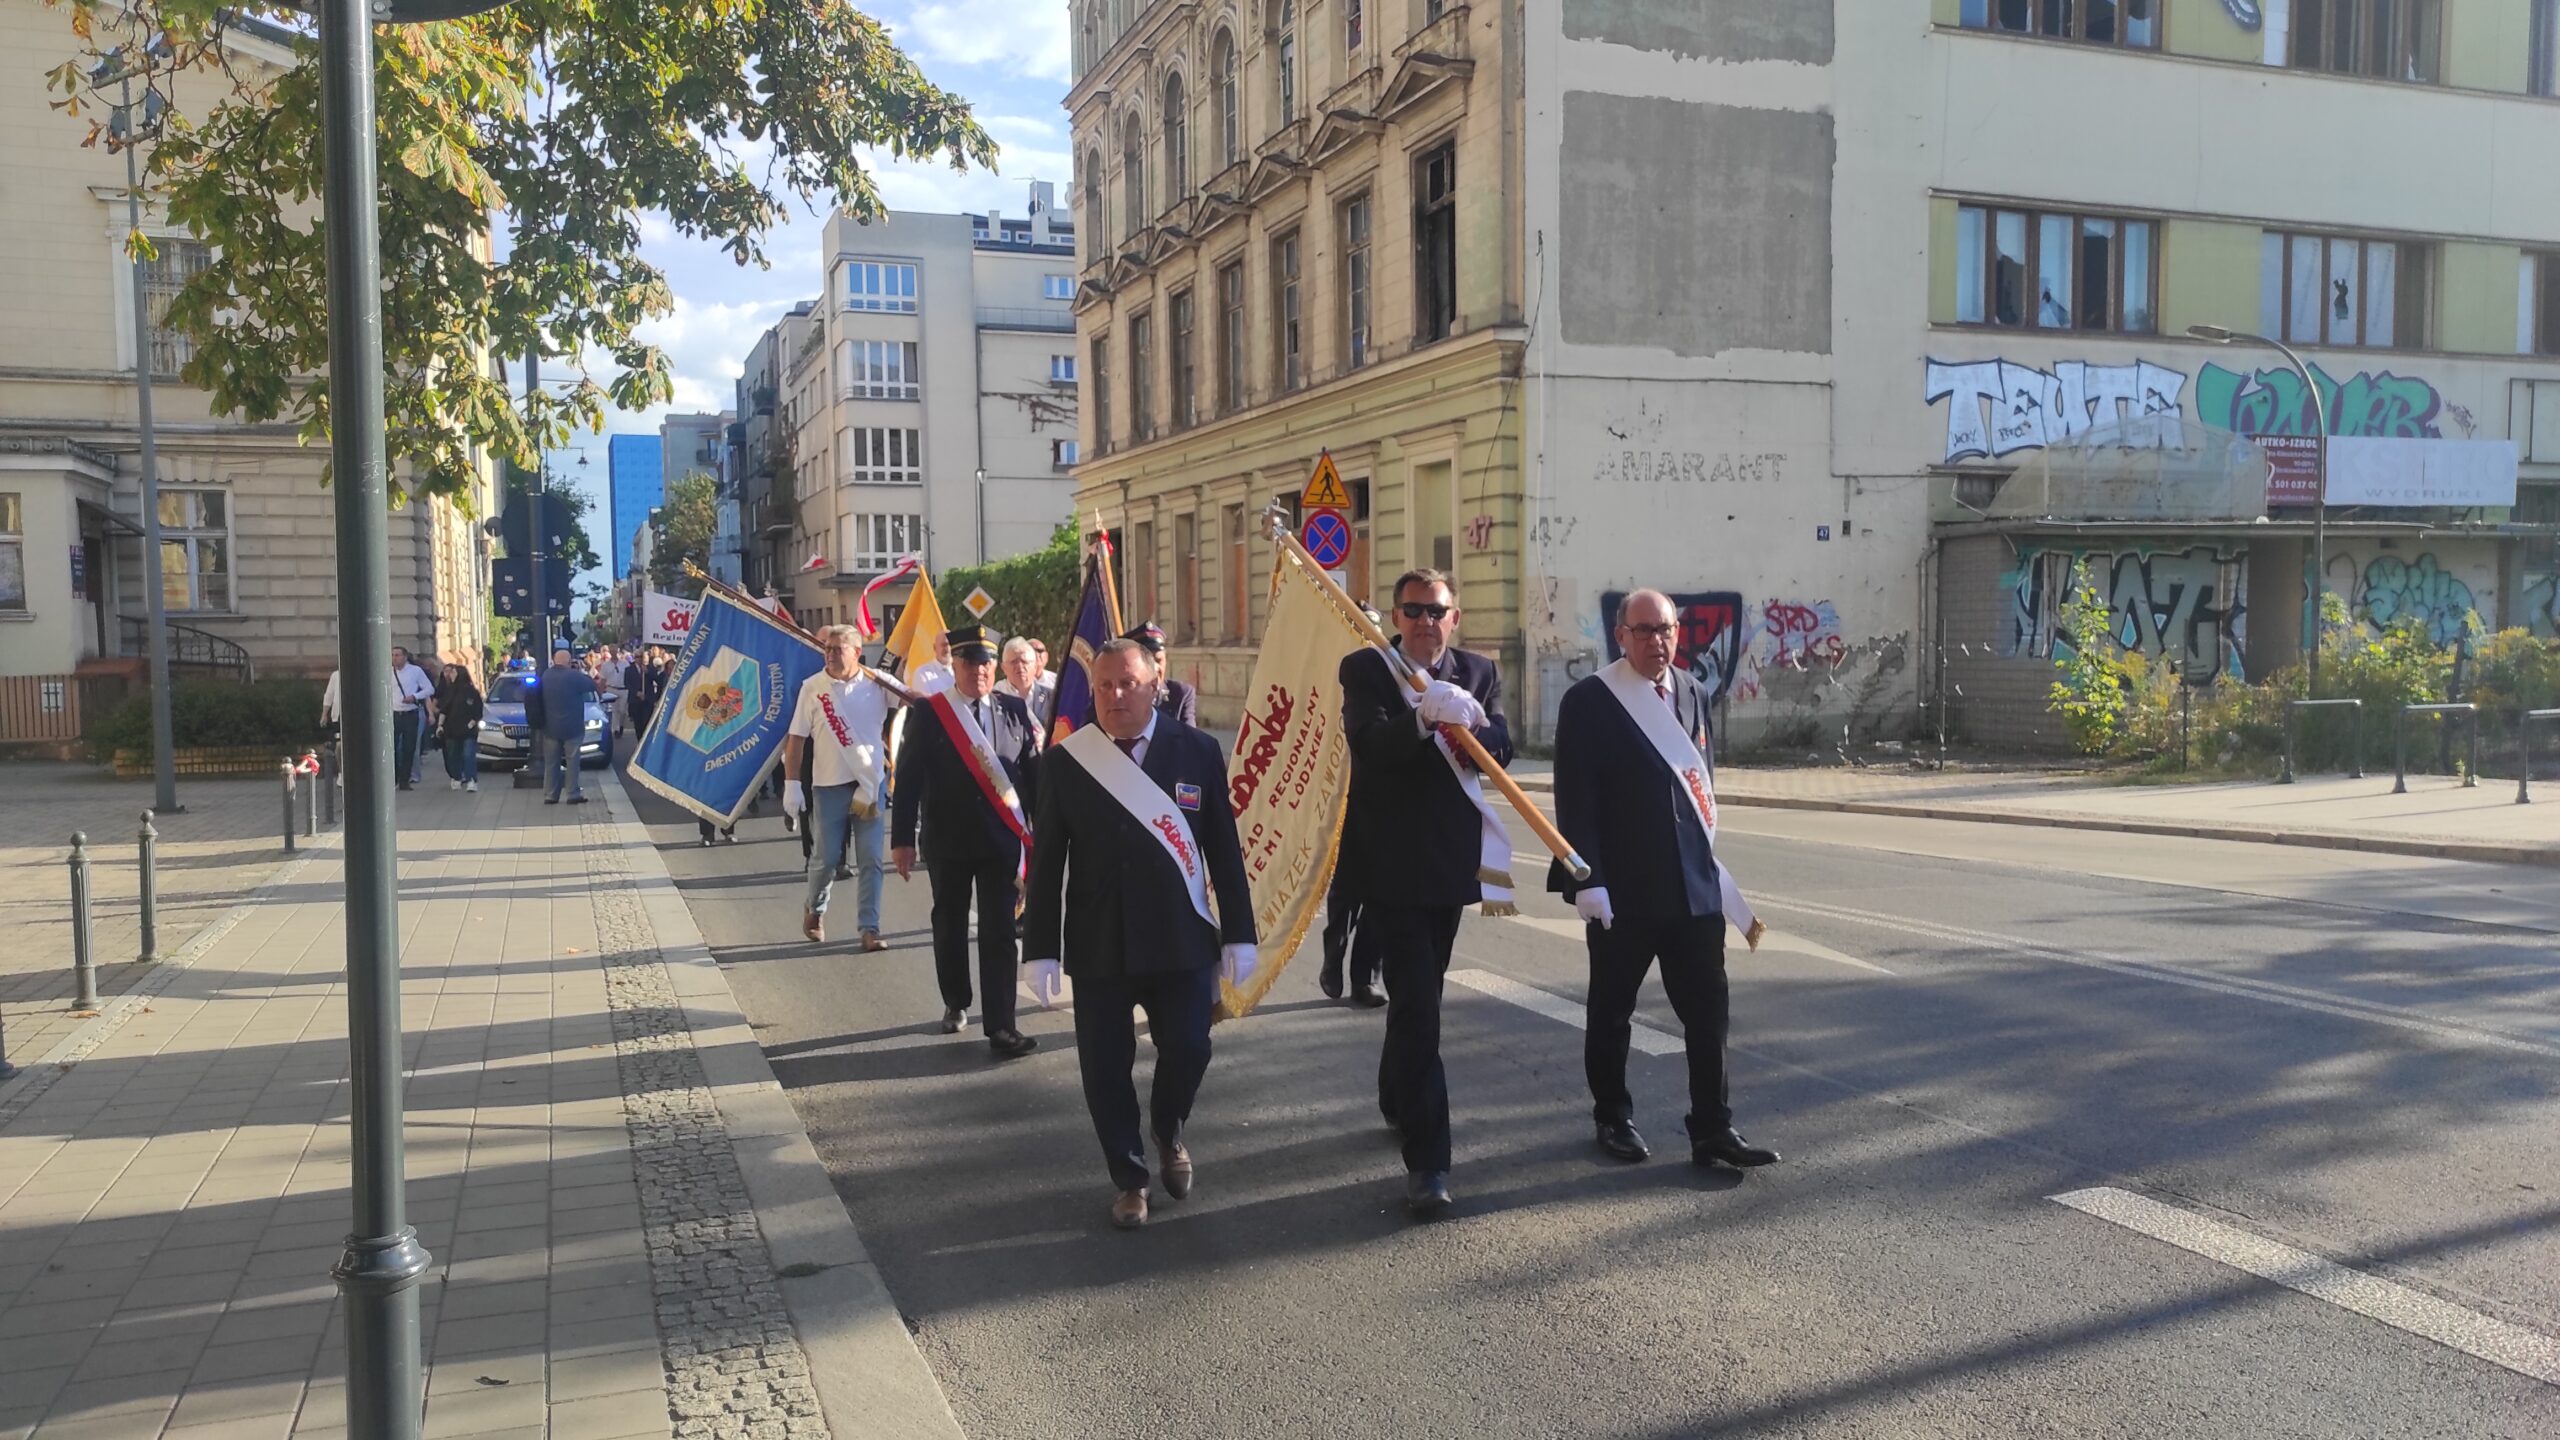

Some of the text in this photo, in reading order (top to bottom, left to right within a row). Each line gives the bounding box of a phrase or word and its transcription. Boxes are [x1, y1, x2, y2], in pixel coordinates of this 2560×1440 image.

[2254, 437, 2317, 449] AUTKO-SZKOŁ
[2365, 488, 2481, 499] WYDRUKI
[1467, 515, 1493, 549] 47
[1818, 528, 1829, 538] 47
[670, 622, 712, 690] SEKRETARIAT
[704, 733, 761, 773] EMERYTÓW
[759, 724, 770, 733] I
[1269, 685, 1320, 809] REGIONALNY
